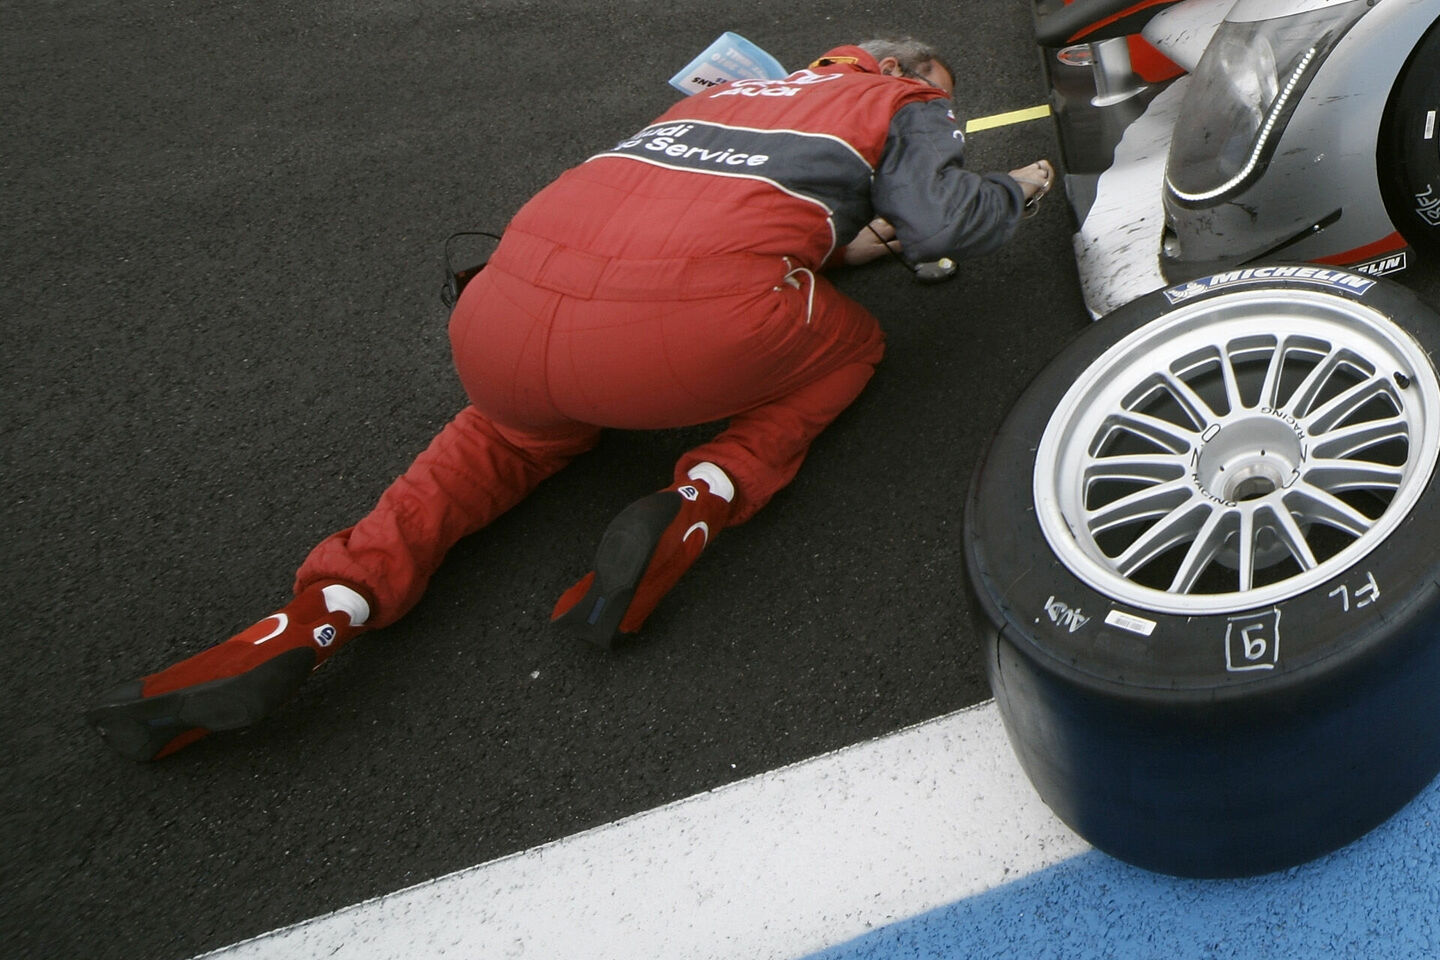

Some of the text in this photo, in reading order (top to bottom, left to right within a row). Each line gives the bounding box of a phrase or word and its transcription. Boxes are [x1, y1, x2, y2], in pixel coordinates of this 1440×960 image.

[691, 77, 718, 89] ANS
[645, 137, 769, 166] Service
[1210, 266, 1372, 290] MICHELIN
[1261, 406, 1305, 440] RACING
[1328, 571, 1380, 612] FL
[1044, 595, 1091, 633] AUDI
[1241, 623, 1267, 660] 9
